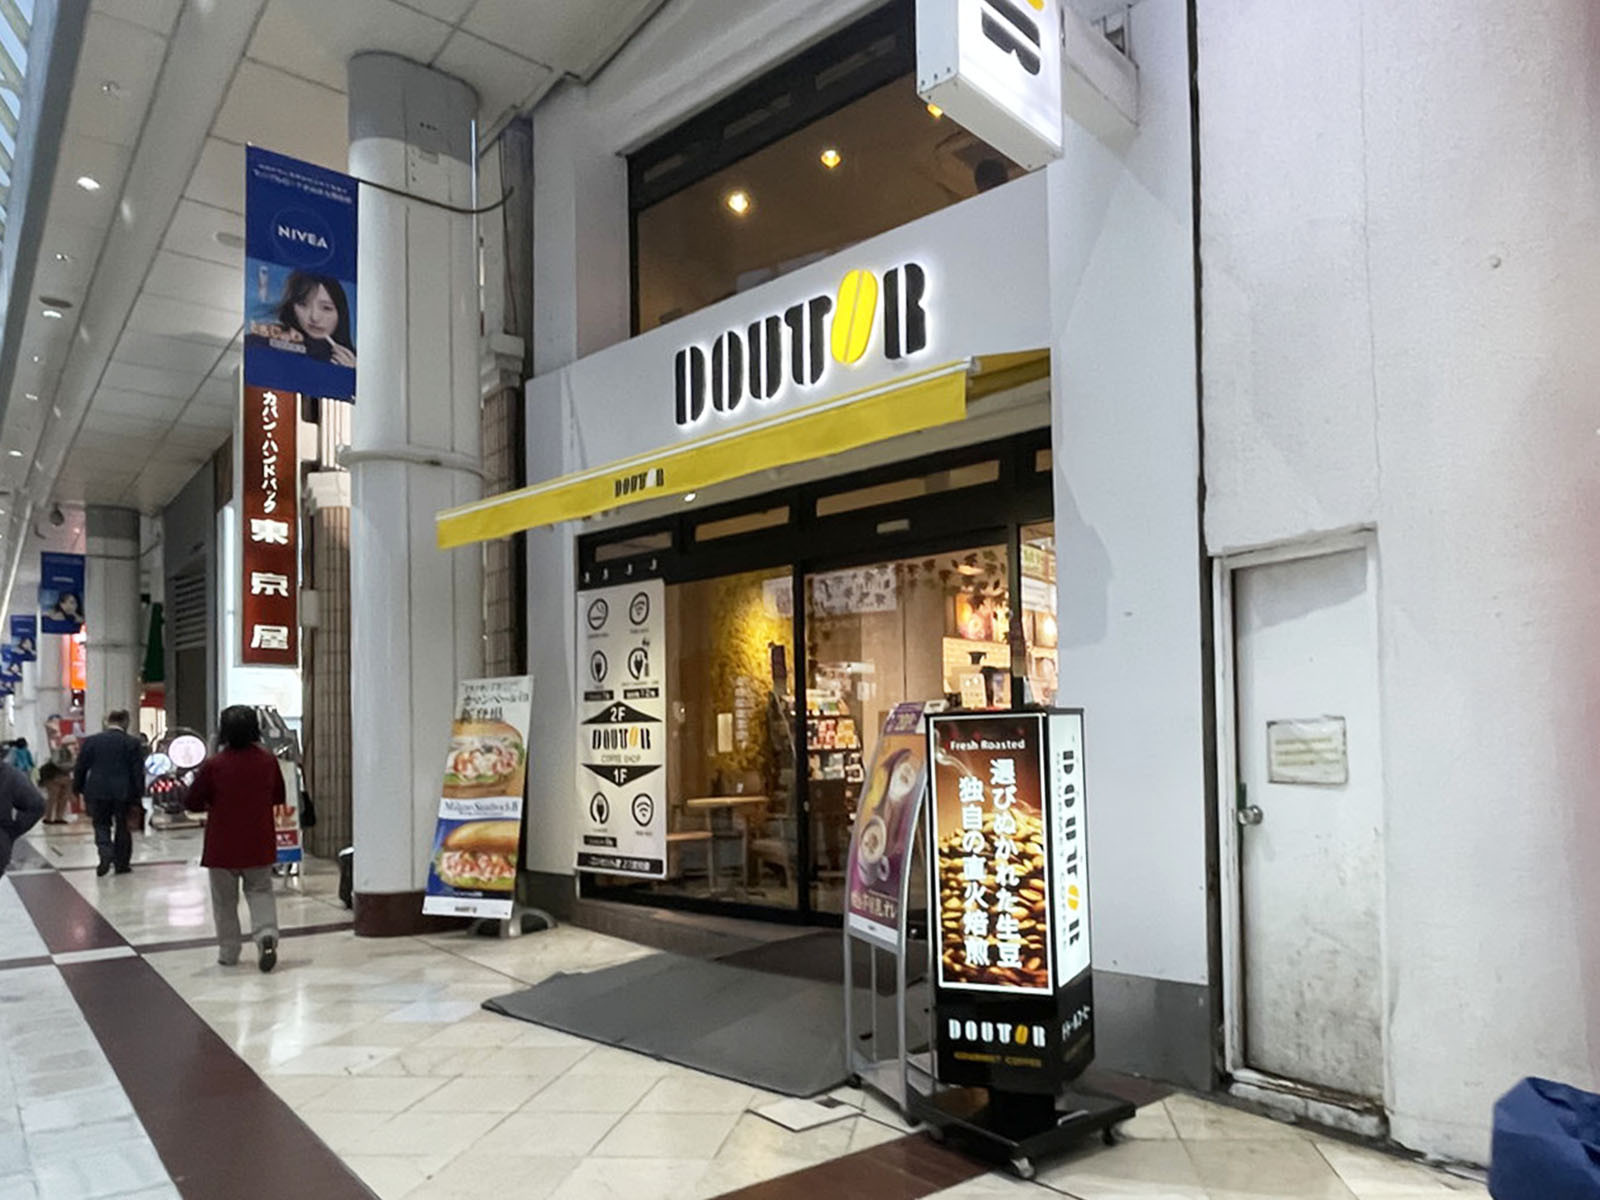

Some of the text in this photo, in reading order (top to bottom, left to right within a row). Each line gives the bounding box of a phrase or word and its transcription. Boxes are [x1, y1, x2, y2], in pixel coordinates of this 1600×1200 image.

[278, 225, 328, 249] NIVEA
[675, 262, 926, 426] DOUTOR
[615, 467, 664, 497] DOUTOR
[250, 518, 289, 650] 東京屋
[610, 706, 627, 722] 2F
[592, 726, 651, 750] DOUTOR
[950, 739, 1025, 751] Fresh Roasted
[614, 768, 628, 784] 1F
[959, 775, 990, 967] 独自の直火焙煎
[990, 758, 1022, 969] 選びぬかれた生豆
[949, 1018, 1046, 1048] DOUTOR
